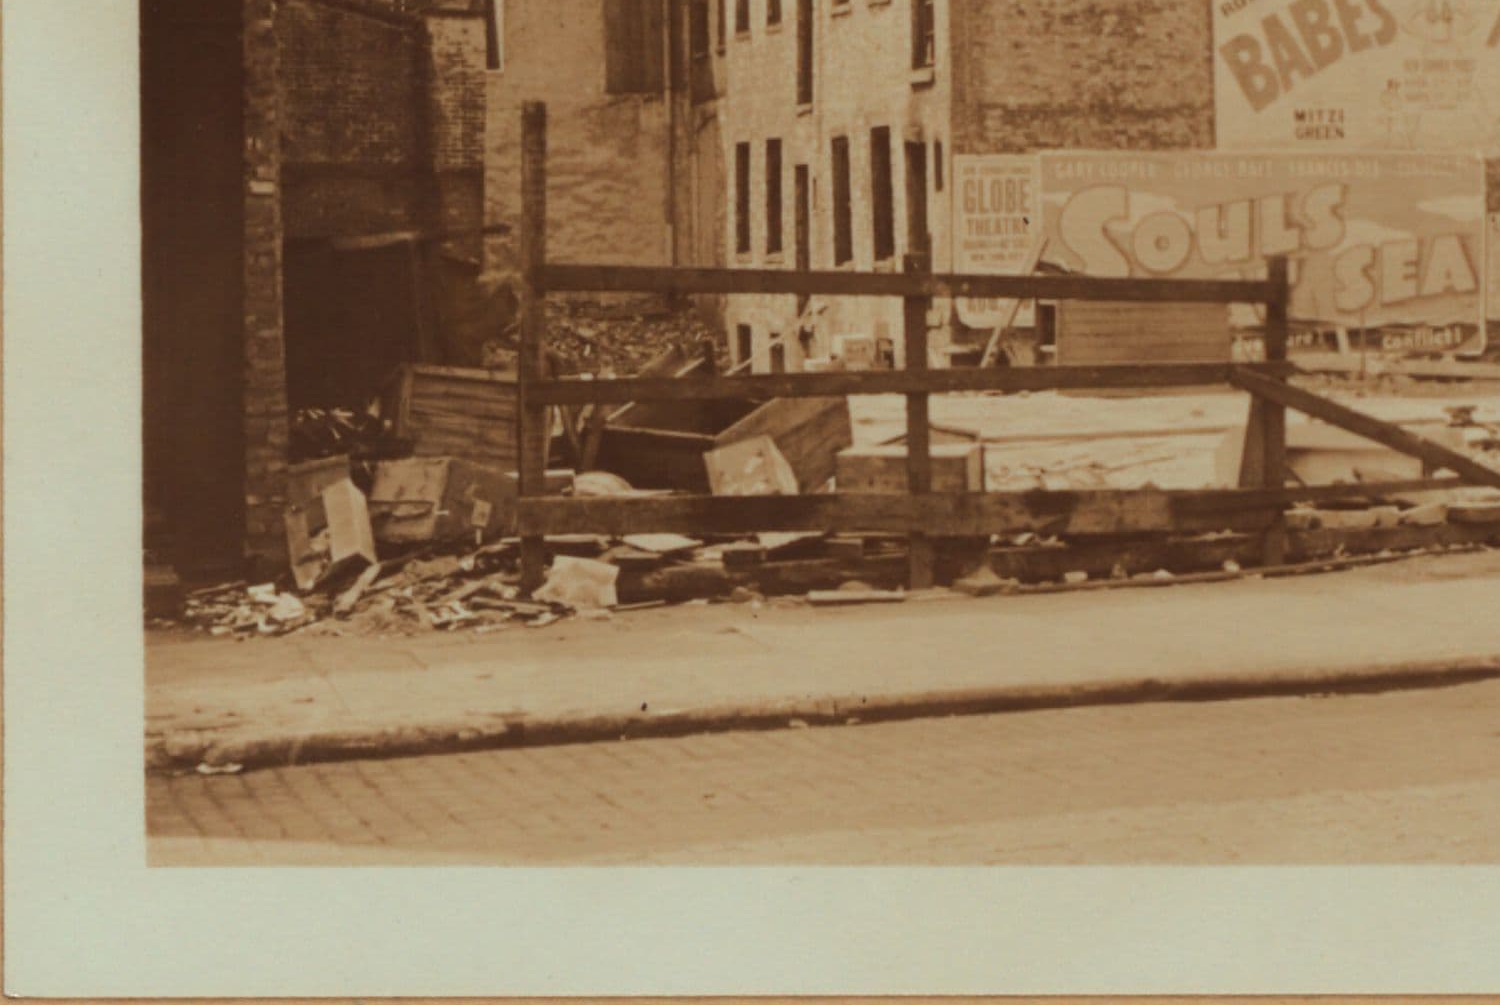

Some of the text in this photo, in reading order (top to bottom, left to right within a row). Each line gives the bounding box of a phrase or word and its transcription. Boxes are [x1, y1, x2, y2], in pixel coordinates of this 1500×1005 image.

[1294, 108, 1344, 123] MITZI
[1295, 124, 1345, 140] GREEN
[963, 179, 1030, 213] GLOBE
[1333, 232, 1480, 314] SEA
